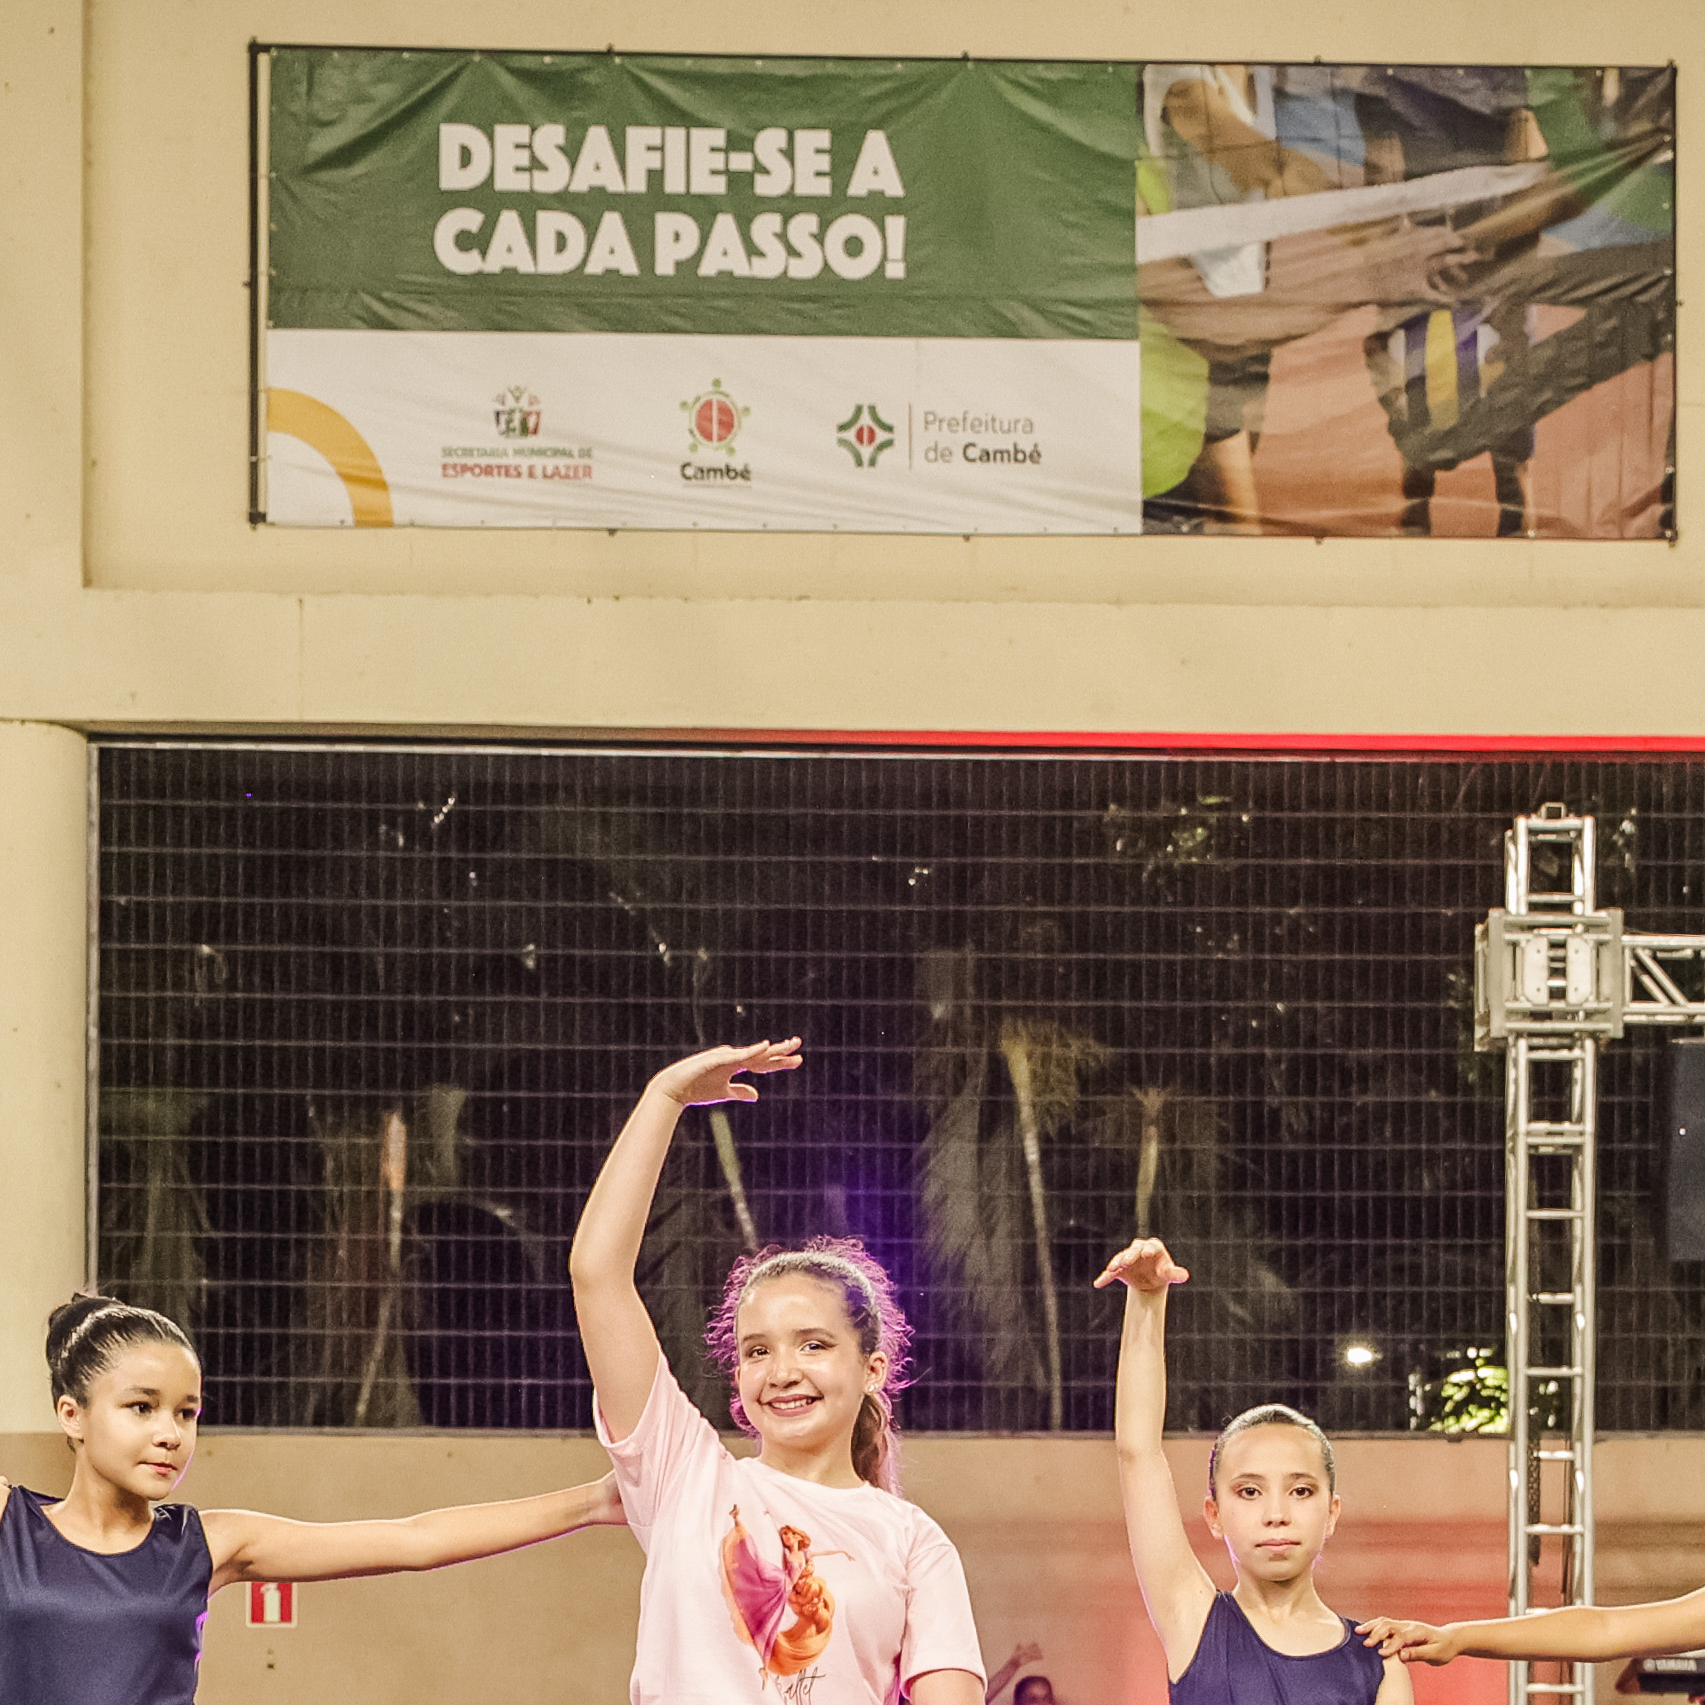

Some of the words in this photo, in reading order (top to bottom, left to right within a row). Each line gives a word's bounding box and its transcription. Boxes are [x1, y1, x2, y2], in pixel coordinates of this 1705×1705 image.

[438, 123, 832, 198] DESAFIE-SE
[846, 129, 906, 198] A
[433, 207, 640, 276] CADA
[654, 211, 907, 280] PASSO!
[923, 410, 1034, 435] Prefeitura
[924, 440, 953, 464] de
[962, 442, 1042, 465] Cambé
[441, 463, 523, 479] ESPORTES
[527, 464, 537, 479] E
[542, 464, 592, 480] LAZER
[680, 461, 752, 482] Cambé
